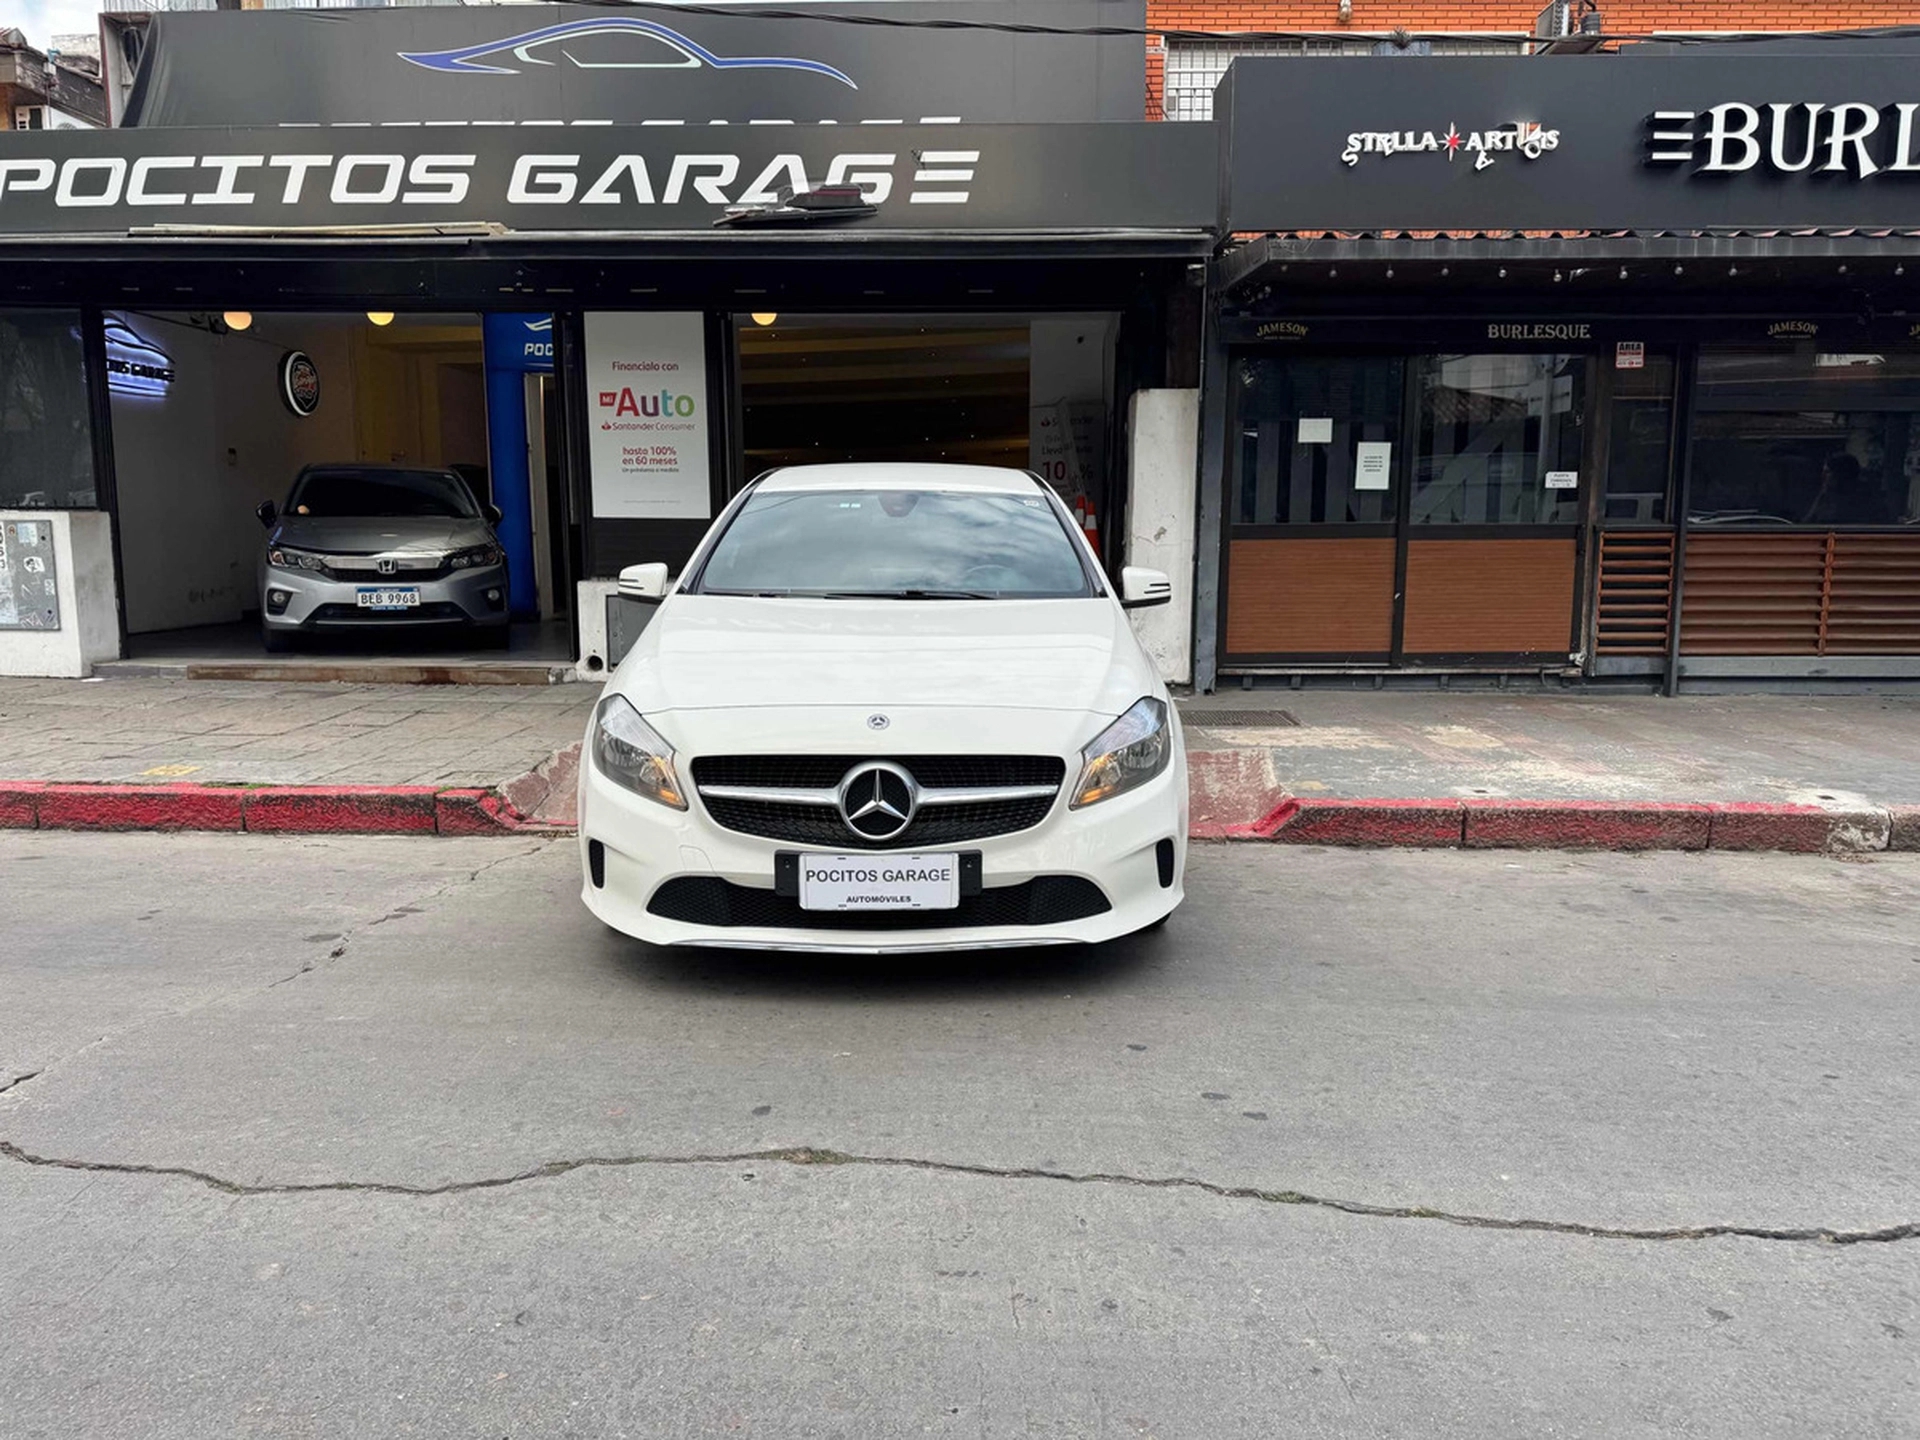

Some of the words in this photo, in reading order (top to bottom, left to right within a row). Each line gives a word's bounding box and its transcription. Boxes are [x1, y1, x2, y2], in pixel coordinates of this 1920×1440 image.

[0, 155, 477, 206] POCITOS
[507, 151, 980, 205] GARAGE
[1256, 321, 1309, 337] JAMESON
[1488, 323, 1592, 340] BURLESQUE
[1767, 320, 1819, 335] JAMESON
[661, 363, 679, 371] con
[616, 387, 695, 417] Auto
[612, 422, 655, 431] Santander
[655, 422, 696, 431] Consumer
[622, 446, 648, 455] hasta
[650, 446, 677, 455] 100%
[622, 457, 634, 465] en
[635, 455, 647, 465] 60
[649, 457, 678, 465] meses
[361, 593, 383, 604] BEB
[388, 593, 417, 604] 9968
[806, 869, 878, 883] POCITOS
[882, 868, 951, 882] GARAGE
